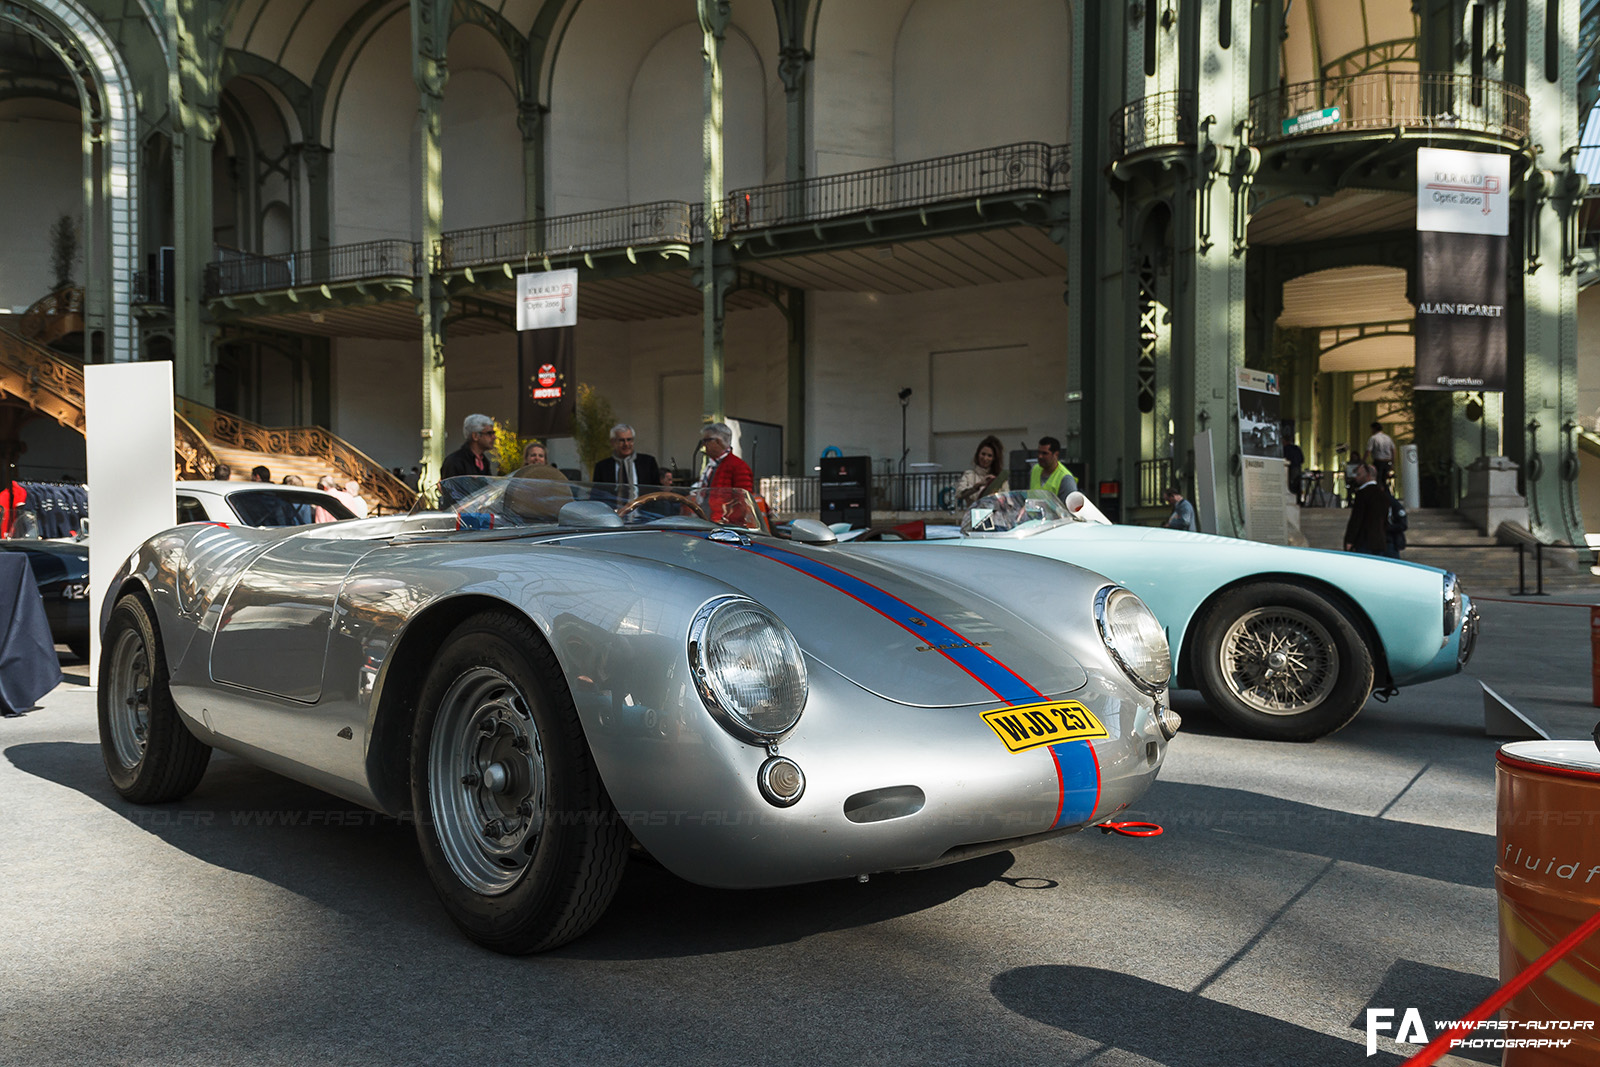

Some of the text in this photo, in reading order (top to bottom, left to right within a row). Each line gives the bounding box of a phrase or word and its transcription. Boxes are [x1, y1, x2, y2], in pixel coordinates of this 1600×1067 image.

[1433, 191, 1457, 204] Optic
[1418, 303, 1504, 317] ALAIN FIGARET
[534, 388, 560, 398] MOTUL
[993, 707, 1095, 742] WJD 257
